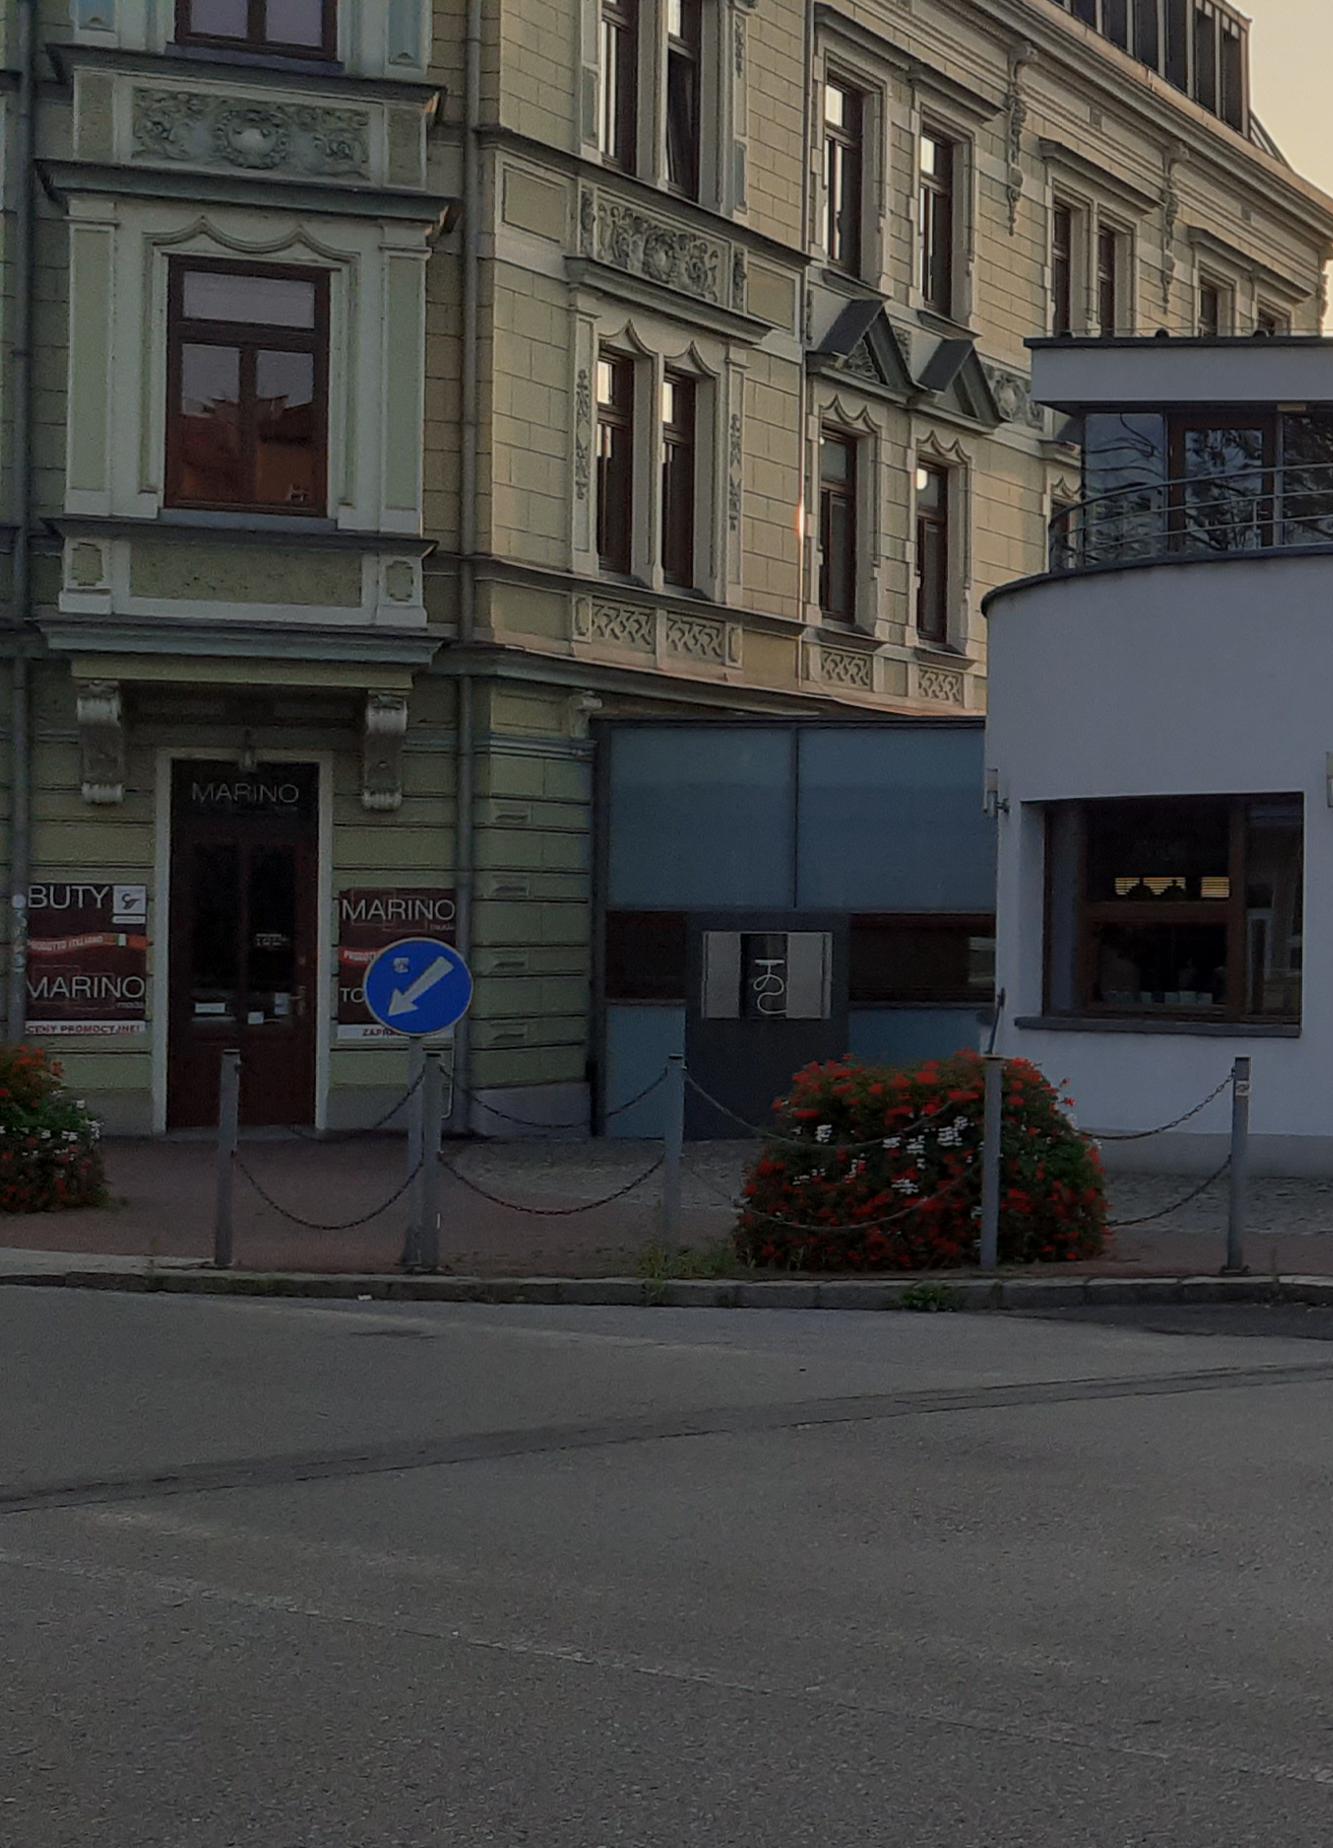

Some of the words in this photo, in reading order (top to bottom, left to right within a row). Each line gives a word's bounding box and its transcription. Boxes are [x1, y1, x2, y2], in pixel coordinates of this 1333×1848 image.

[191, 782, 300, 804] MARINO
[28, 885, 111, 909] BUTY
[341, 899, 456, 921] MARINO
[26, 976, 146, 999] MARINO
